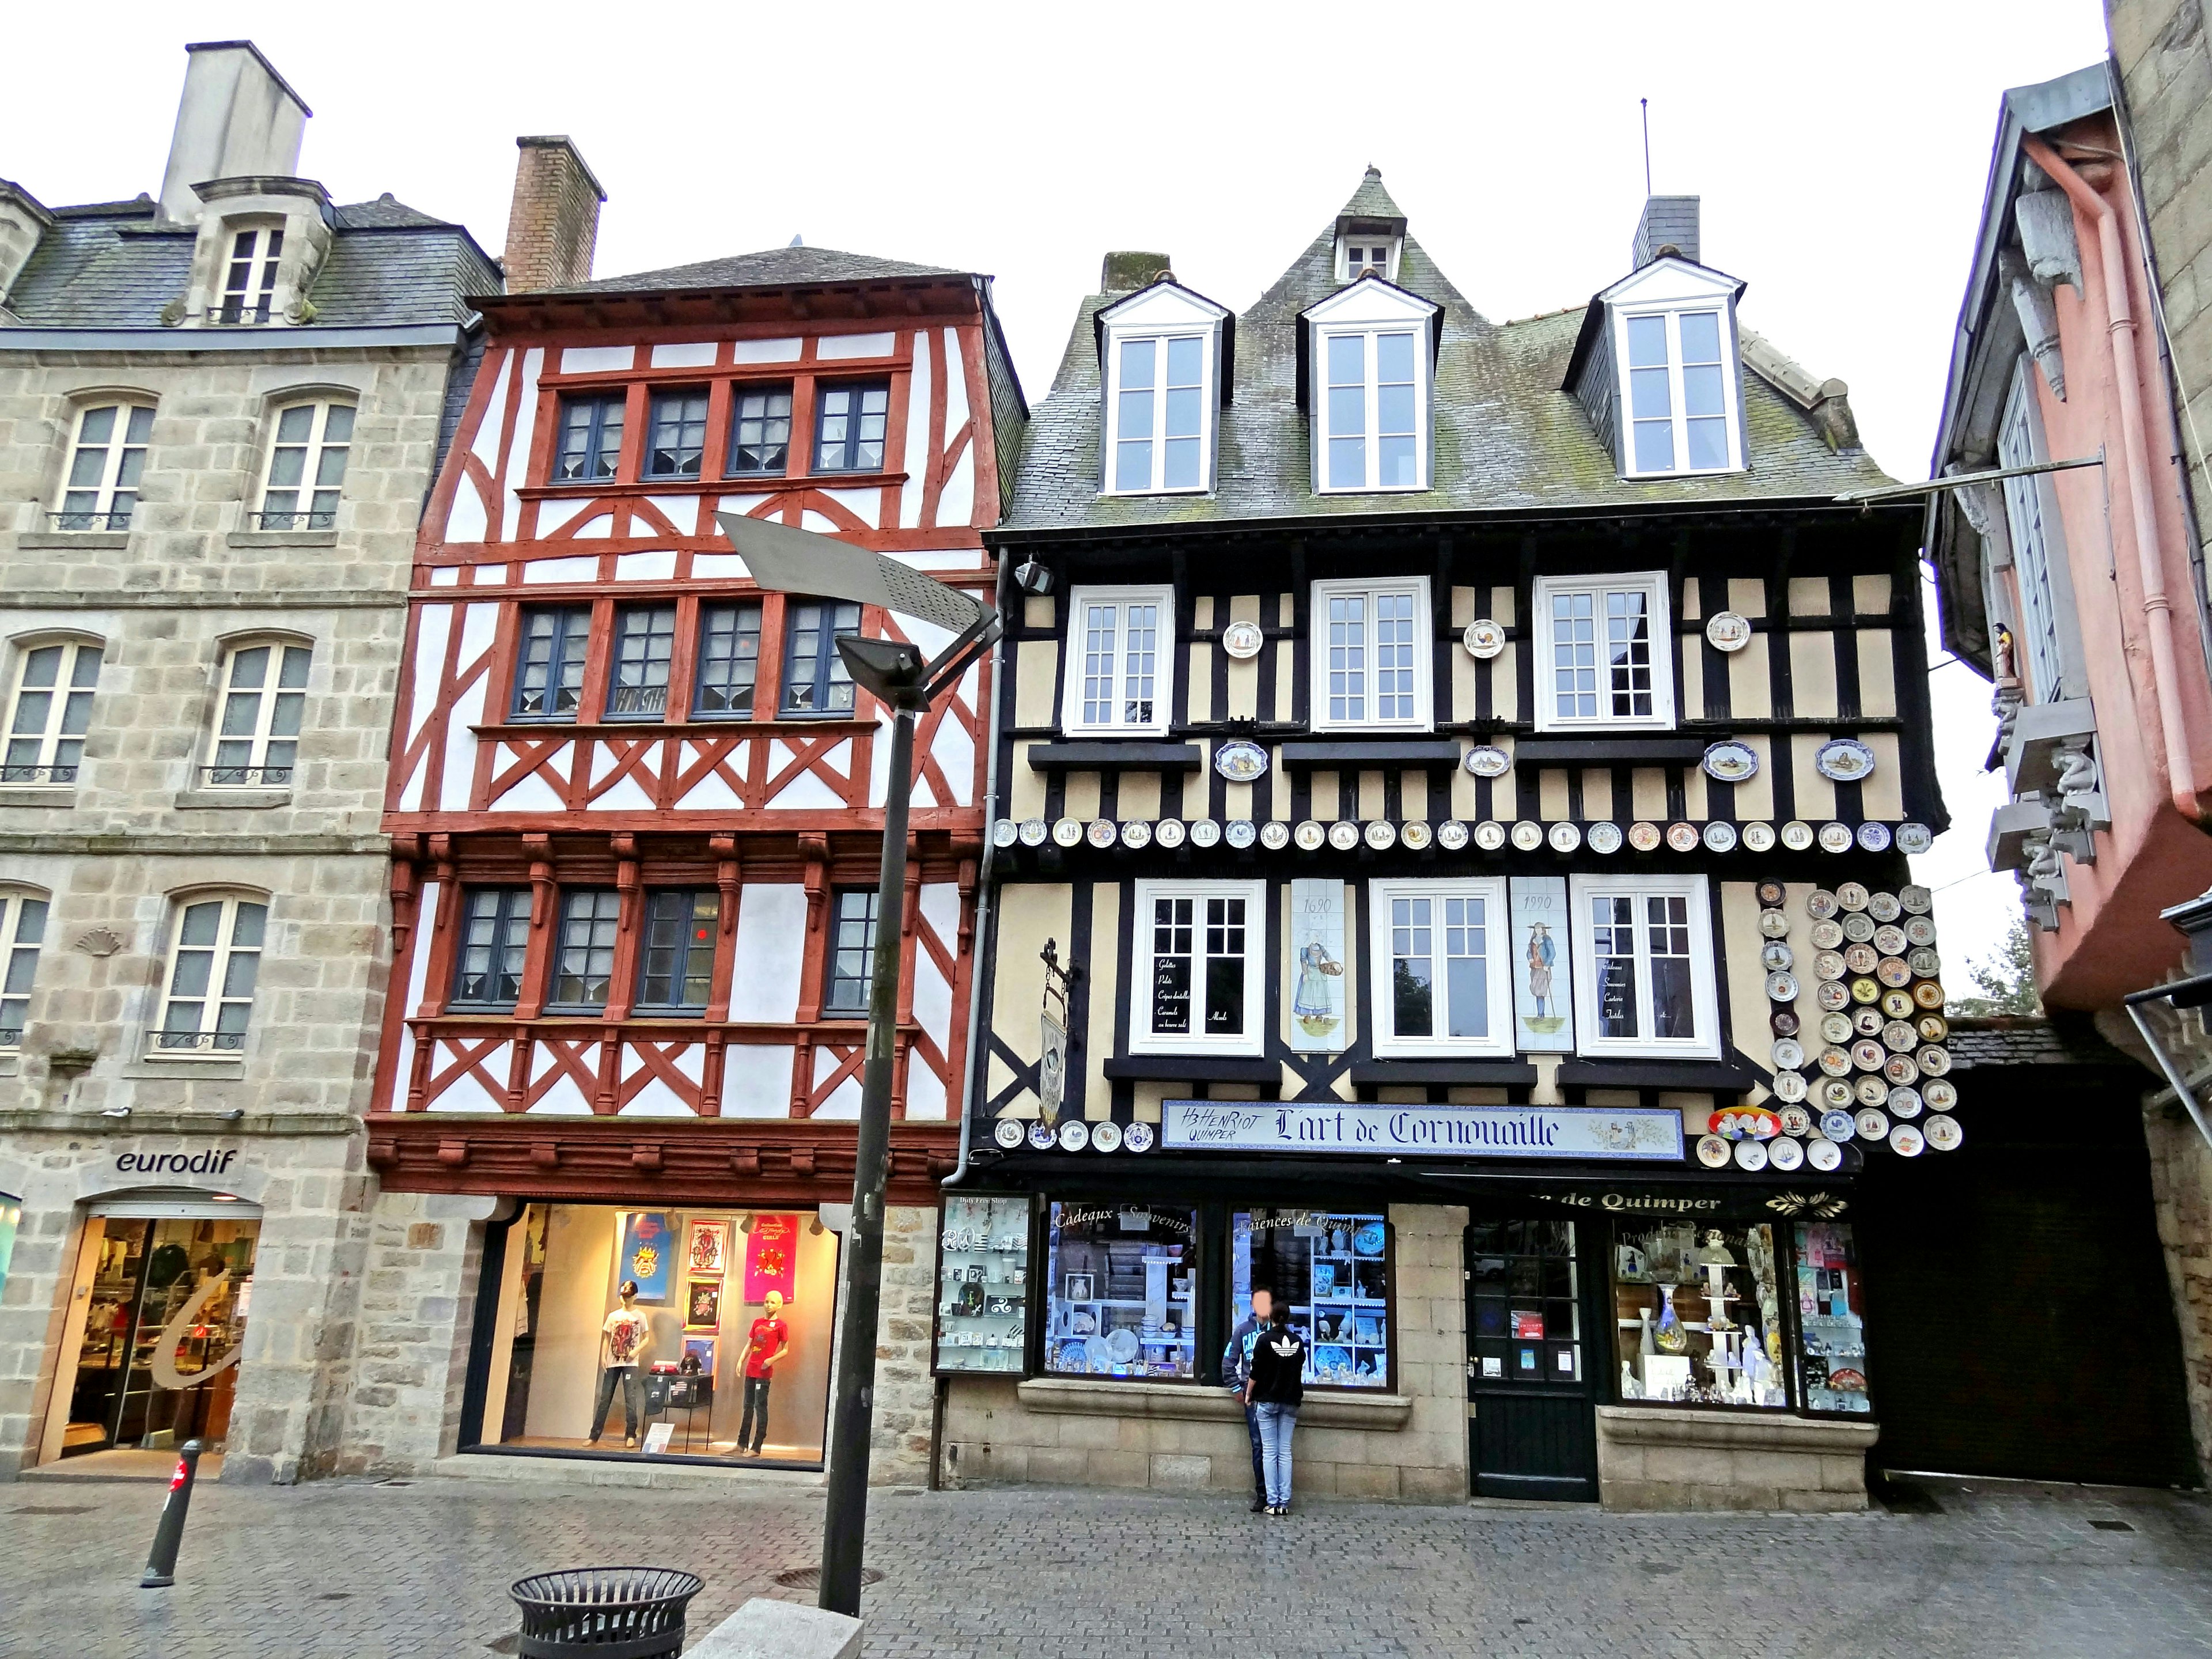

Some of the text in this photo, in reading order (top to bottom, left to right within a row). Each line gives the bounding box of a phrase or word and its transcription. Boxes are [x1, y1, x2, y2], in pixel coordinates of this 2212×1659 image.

[1304, 899, 1331, 913] 1690
[1524, 896, 1551, 909] 1990
[1356, 1118, 1378, 1142] de
[1389, 1112, 1560, 1147] Cornouaille
[117, 1149, 237, 1173] eurodif
[1561, 1192, 1721, 1212] de Quimper
[1055, 1208, 1113, 1228] Cadeaux
[1130, 1206, 1191, 1233] Souvenirs
[1296, 1212, 1311, 1226] de
